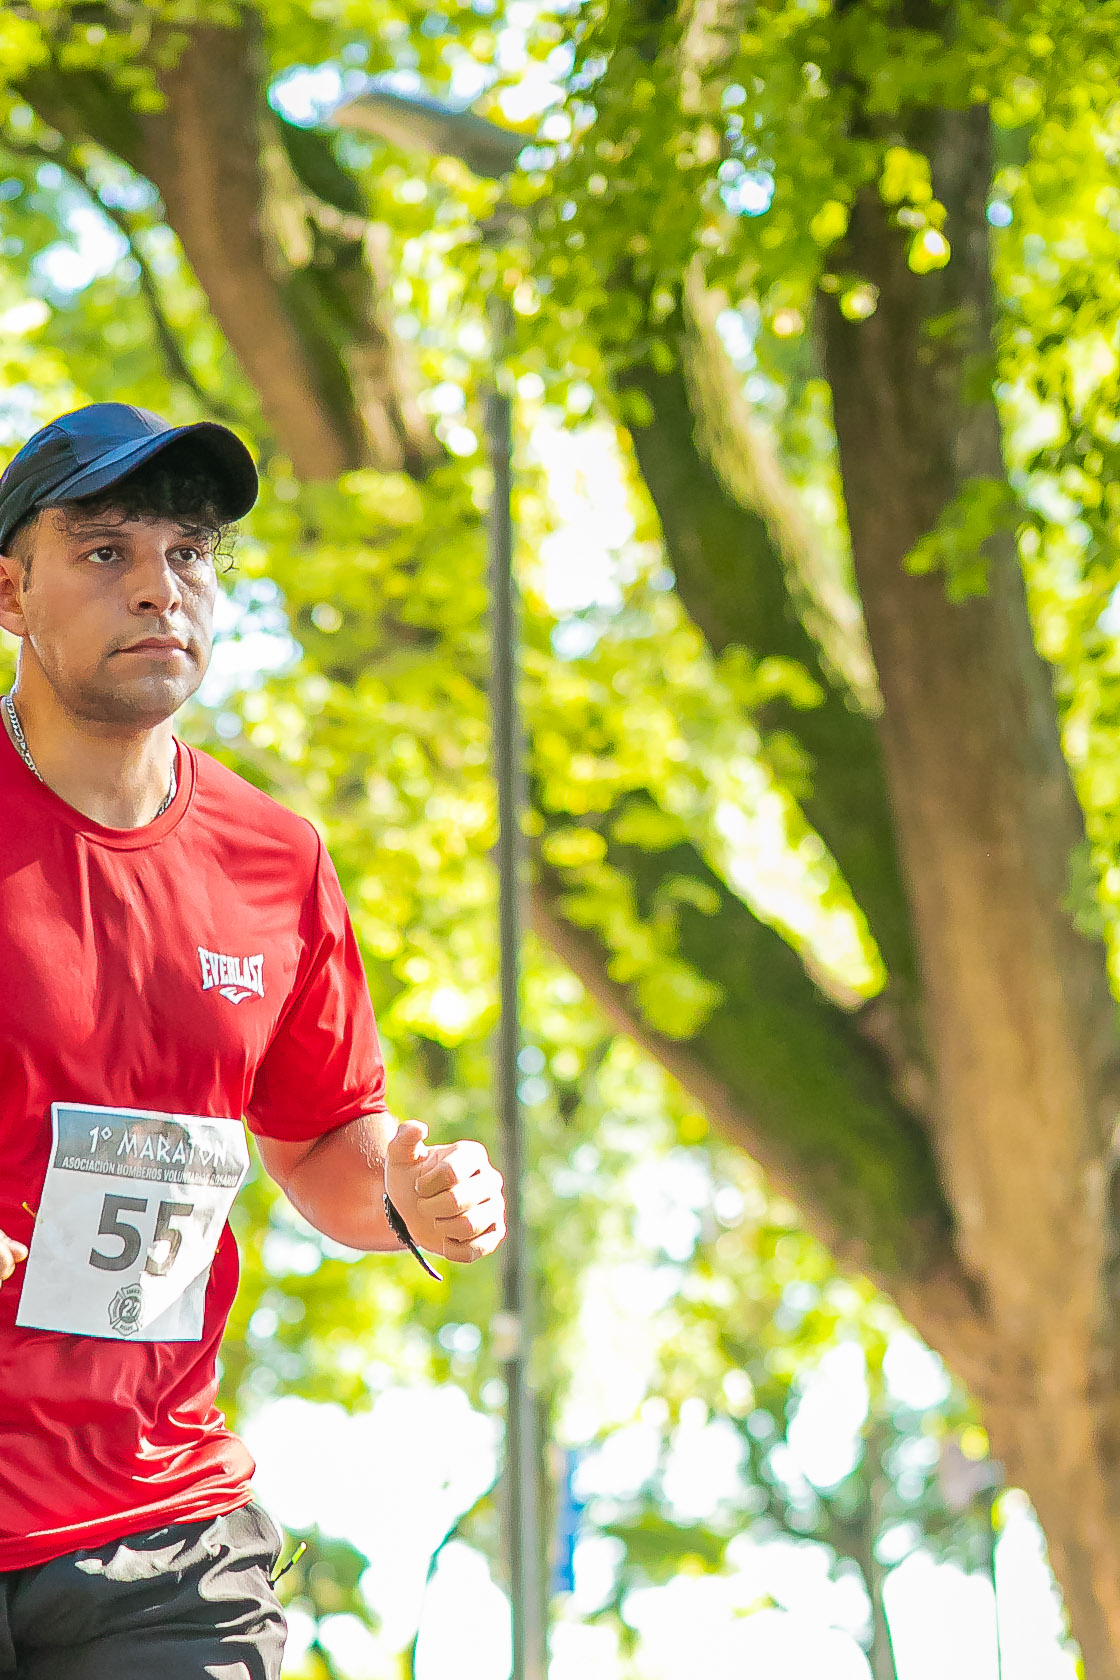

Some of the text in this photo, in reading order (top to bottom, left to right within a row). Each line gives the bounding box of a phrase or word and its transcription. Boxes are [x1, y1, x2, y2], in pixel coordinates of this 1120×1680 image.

[197, 945, 265, 998] EVERLAST
[116, 1164, 162, 1181] BOMBEROS
[88, 1193, 195, 1277] 55
